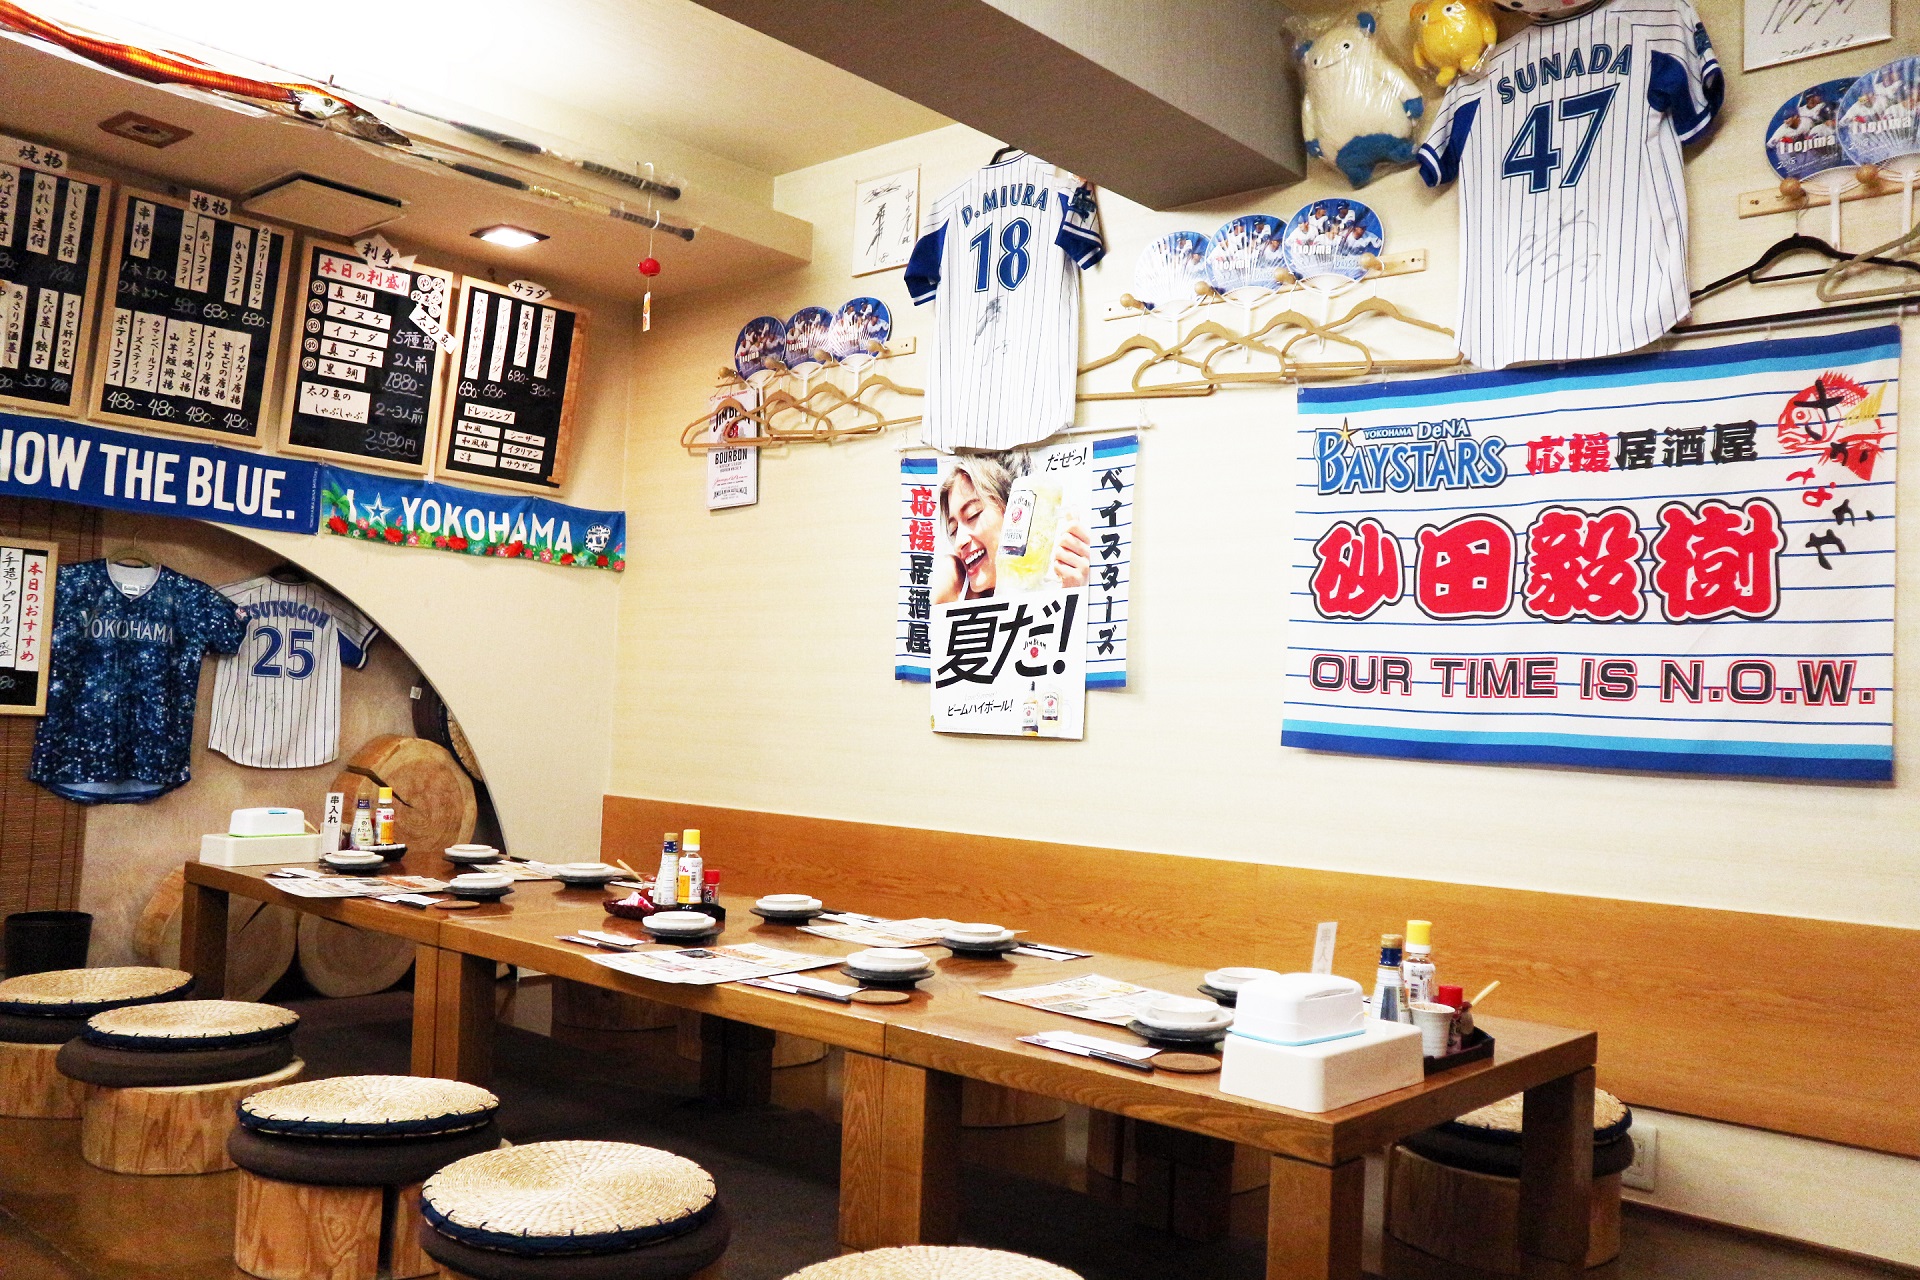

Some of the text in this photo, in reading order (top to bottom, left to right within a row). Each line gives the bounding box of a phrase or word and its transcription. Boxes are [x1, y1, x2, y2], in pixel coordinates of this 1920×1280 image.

[1497, 44, 1632, 105] SUNADA
[1502, 83, 1620, 194] 47
[30, 180, 52, 248] かれい煮付
[62, 187, 82, 258] いしもち煮付
[132, 205, 150, 252] 串揚げ
[192, 194, 228, 216] 揚物
[195, 229, 211, 286] あじフライ
[229, 240, 246, 299] かきフライ
[252, 226, 270, 305] カニクリームコロッケ
[970, 216, 1031, 292] 18
[512, 282, 548, 299] サラダ
[6, 290, 23, 364] あさりの酒蒸し
[35, 293, 54, 364] えび蒸し餃子
[110, 314, 128, 380] ポテトフライ
[328, 342, 376, 362] 真ゴチ
[334, 326, 378, 342] イナダ
[179, 327, 198, 392] とろろ磯辺揚
[198, 330, 217, 397] メヒカリ唐揚
[214, 341, 232, 400] 甘エビの唐揚
[230, 344, 247, 404] イカゲソ唐揚
[324, 363, 358, 380] 黒鯛
[393, 352, 428, 376] 2人前
[306, 385, 350, 401] 太刀魚の
[315, 404, 364, 420] しゃぶしゃぶ
[468, 406, 512, 420] ドレッシング
[464, 422, 482, 434] 和風
[508, 446, 540, 458] イタリアン
[510, 432, 540, 442] シーザー
[715, 448, 748, 464] BOURBON
[1364, 418, 1470, 440] YOKOHAMA DeNA
[1526, 420, 1758, 476] 応援居酒屋
[99, 443, 180, 504] THE
[186, 456, 295, 520] BLUE.
[459, 452, 472, 462] ごま
[506, 460, 534, 471] サウザン
[1314, 428, 1508, 495] BAYSTARS
[402, 496, 572, 553] YOKOHAMA
[906, 486, 935, 654] 応援居酒屋
[1097, 468, 1123, 656] ベイスターズ
[20, 561, 43, 662] 本日のおすすめ
[80, 610, 174, 645] YOKOHAMA
[251, 626, 316, 680] 25
[936, 594, 1080, 689] 夏だ!
[948, 699, 1013, 716] ビームハイボール!
[1310, 654, 1876, 705] OUR TIME IS N.O.W.
[328, 796, 340, 824] 串入れ
